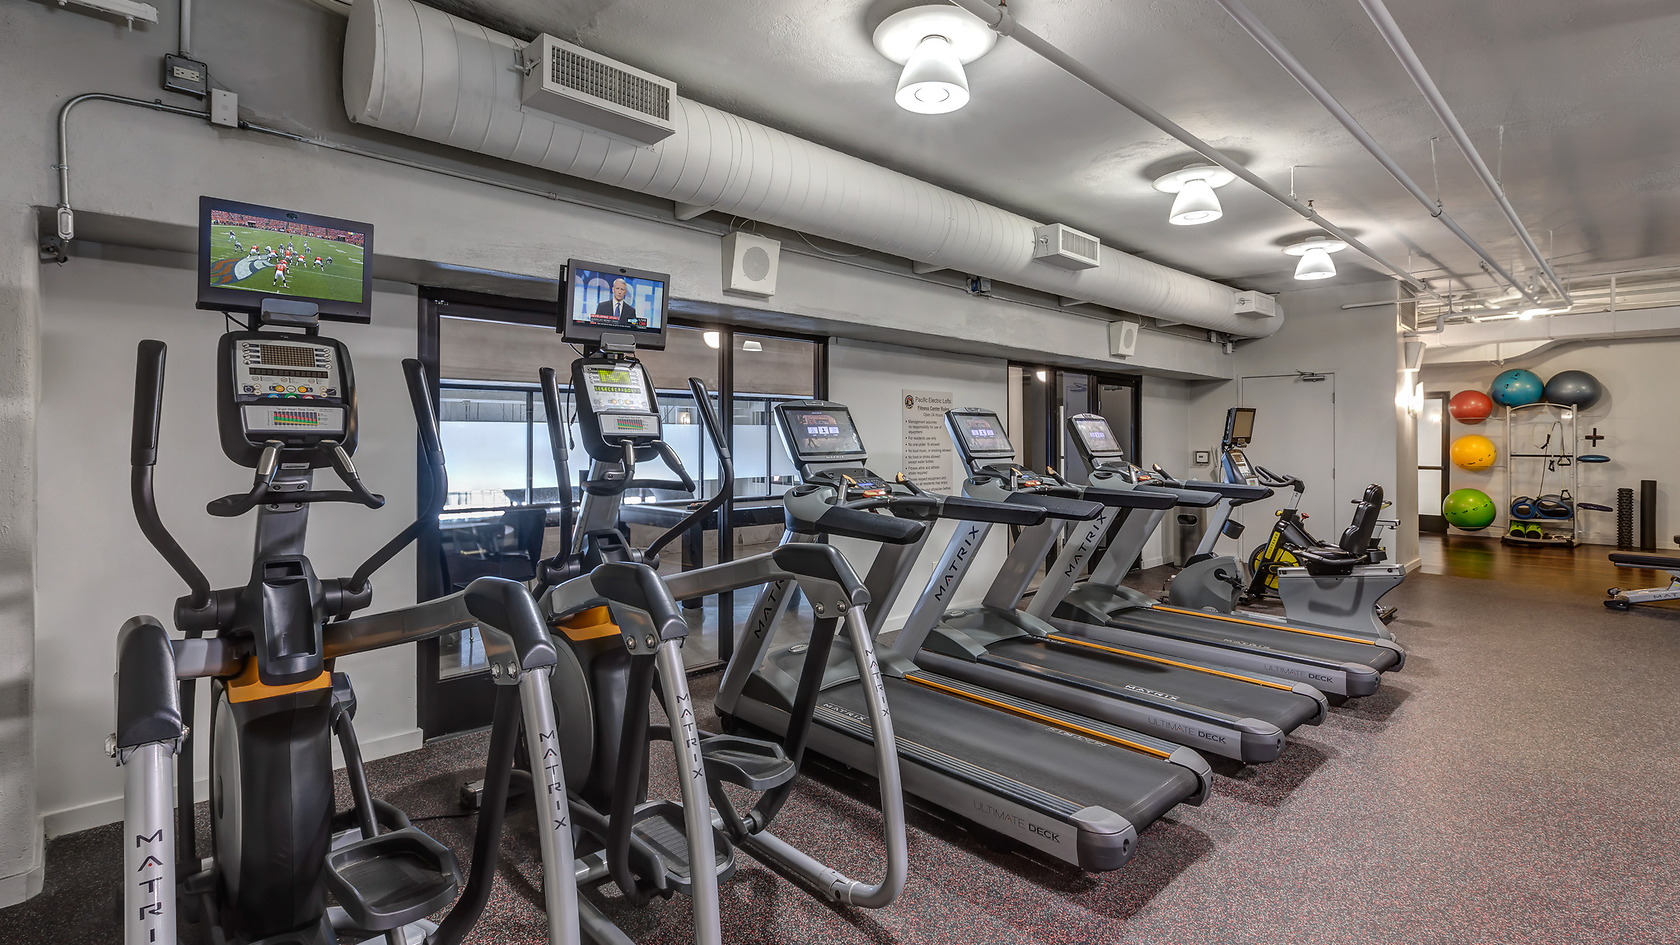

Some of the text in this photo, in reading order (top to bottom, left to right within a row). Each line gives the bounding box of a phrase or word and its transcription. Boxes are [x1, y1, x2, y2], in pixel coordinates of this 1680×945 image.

[934, 525, 980, 602] MATRIX
[1064, 513, 1106, 578] MATRIX
[865, 648, 890, 717] MATRIX
[1124, 683, 1180, 701] MATRIX
[1264, 663, 1334, 684] ULTIMATE DECK
[676, 693, 703, 779] MATRIX
[822, 702, 868, 721] MATRIX
[1147, 716, 1227, 745] ULTIMATE DECK
[539, 729, 568, 831] MATRIX
[973, 800, 1061, 844] ULTIMATE DECK
[136, 828, 164, 943] MATRI
